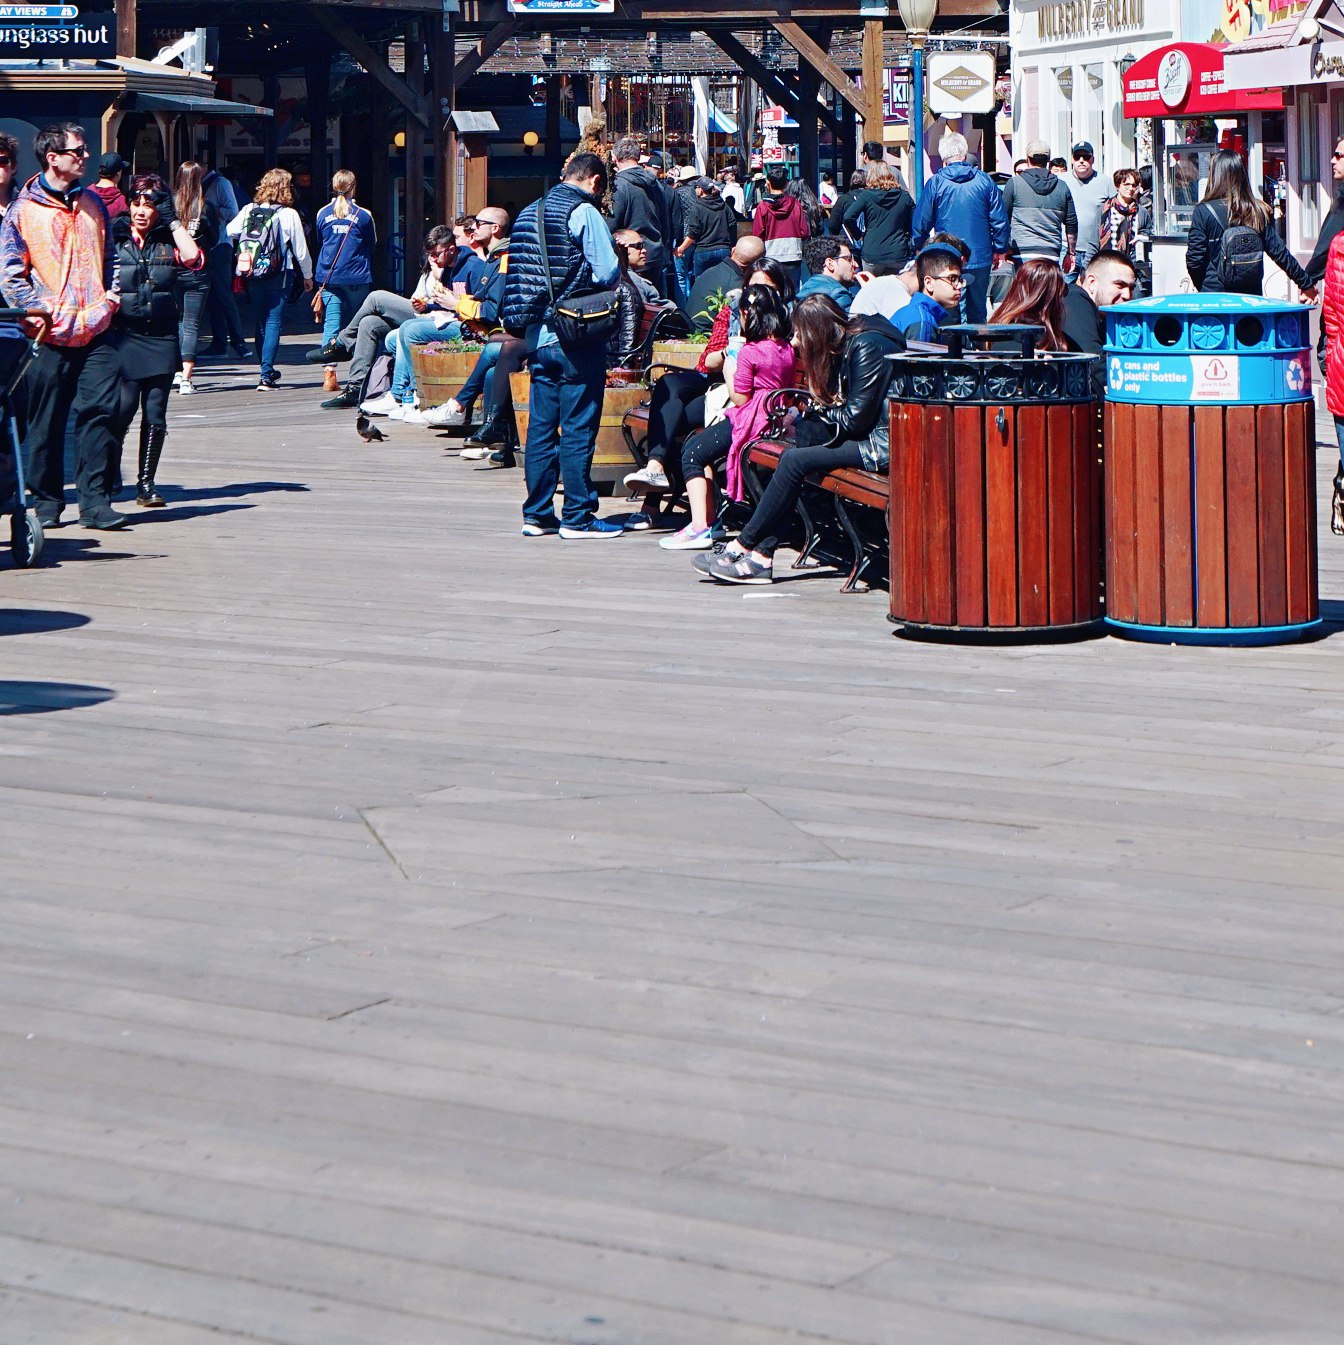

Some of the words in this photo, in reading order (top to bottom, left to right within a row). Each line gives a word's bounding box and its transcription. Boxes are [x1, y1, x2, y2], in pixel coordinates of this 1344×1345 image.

[537, 0, 563, 8] Straight
[564, 0, 584, 8] Ahead
[13, 6, 47, 16] VIEWS
[73, 23, 109, 44] hut
[1124, 362, 1141, 371] cans
[1142, 361, 1160, 371] and
[1124, 371, 1151, 383] plastic
[1152, 371, 1188, 383] bottles
[1124, 383, 1141, 393] only
